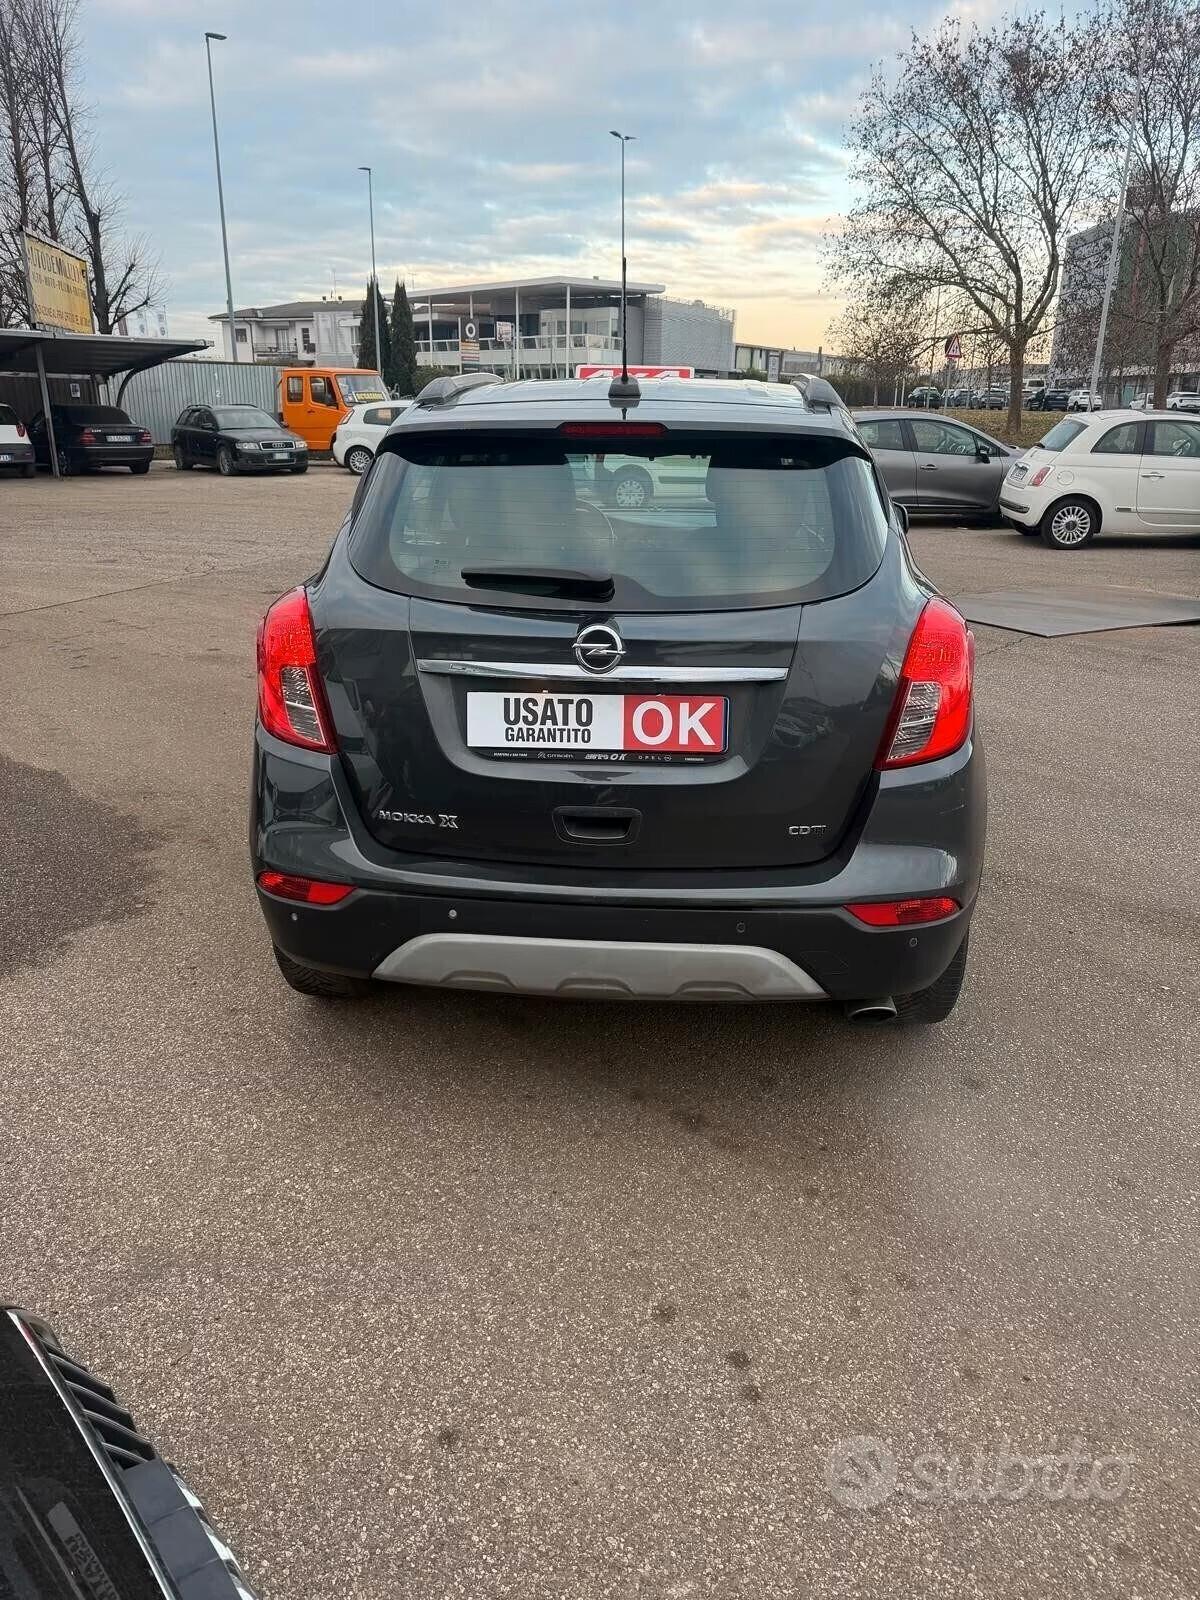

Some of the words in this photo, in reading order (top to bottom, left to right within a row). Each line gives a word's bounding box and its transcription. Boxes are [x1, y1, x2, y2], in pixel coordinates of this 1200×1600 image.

[503, 697, 593, 727] USATO
[632, 700, 717, 746] OK
[505, 727, 591, 744] GARANTITO
[379, 810, 435, 824] MOKKA
[438, 814, 459, 829] X
